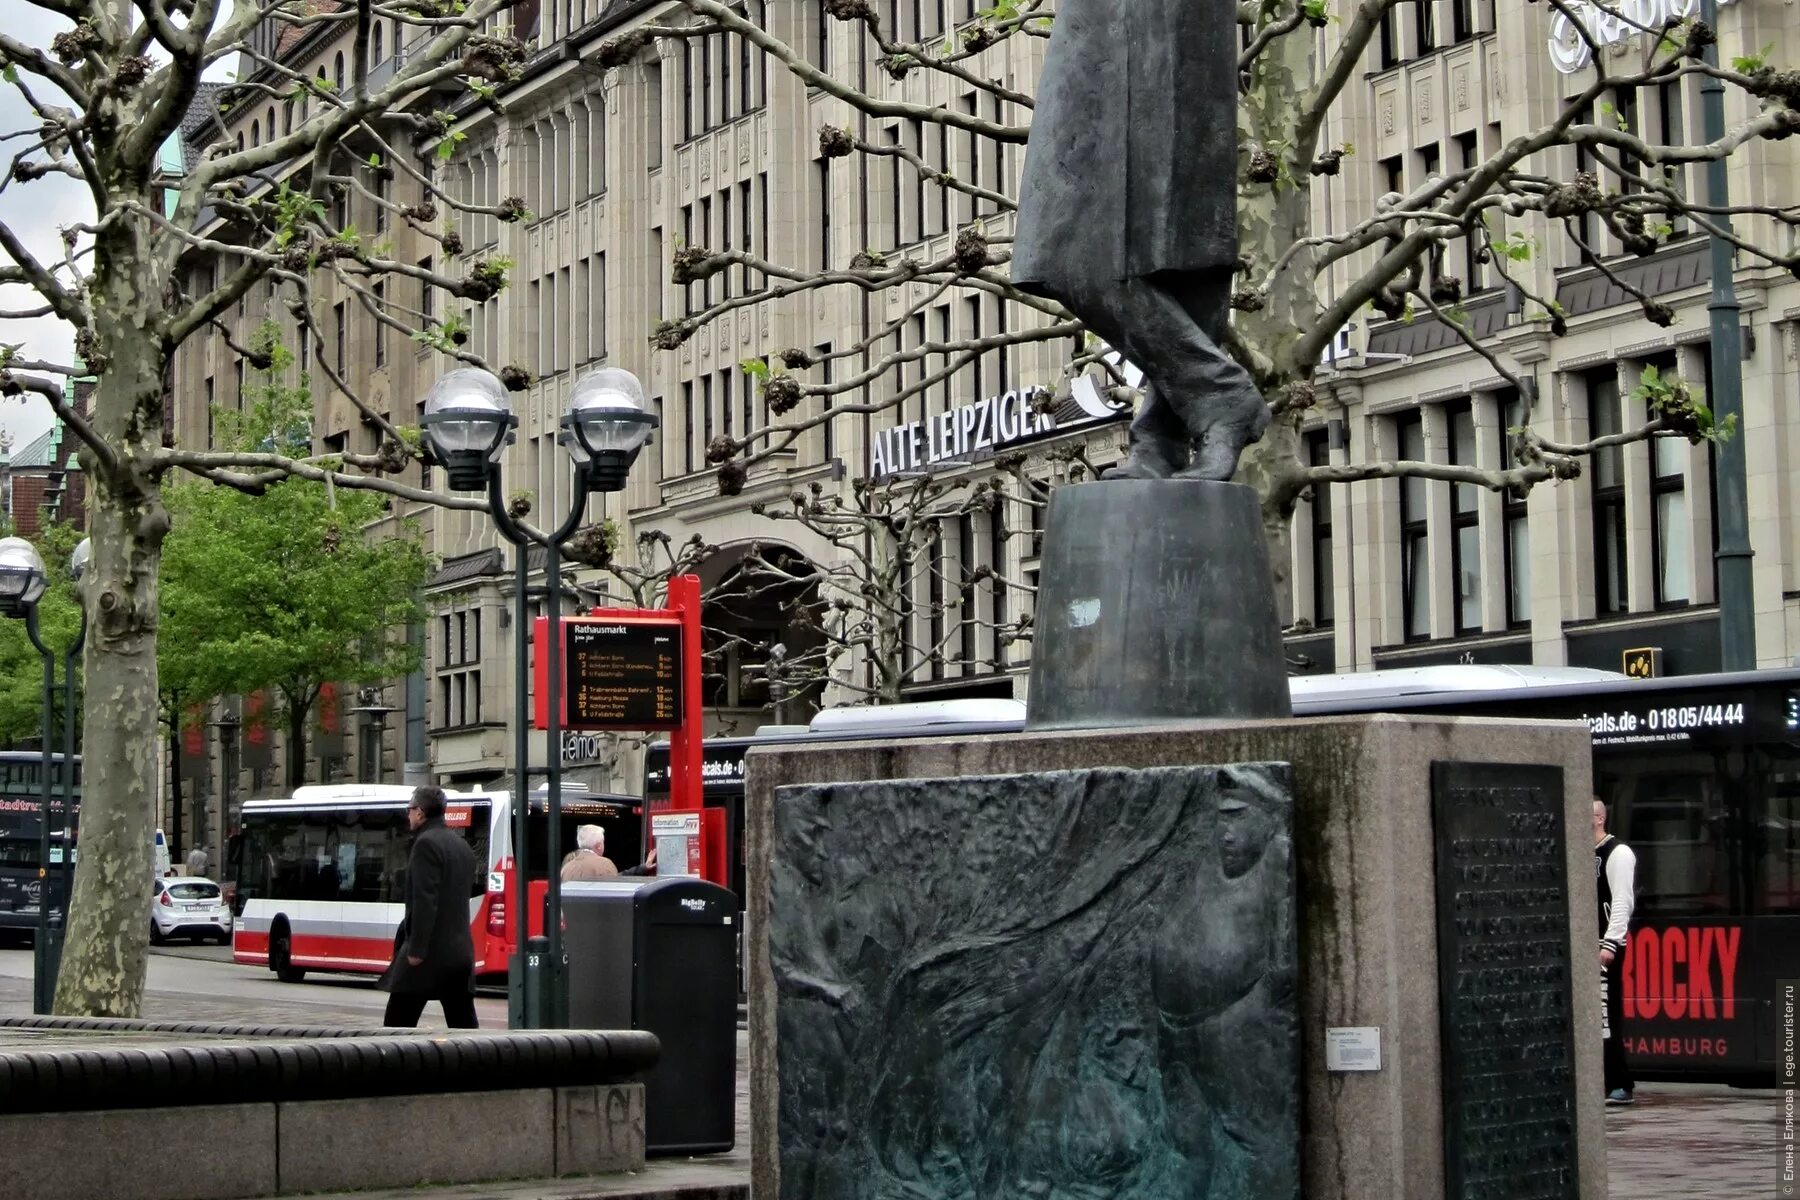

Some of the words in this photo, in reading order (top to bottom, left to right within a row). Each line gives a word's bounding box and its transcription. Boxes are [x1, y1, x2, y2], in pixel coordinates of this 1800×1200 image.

[871, 420, 921, 476] ALTE
[927, 384, 1053, 461] LEIPZIGER
[574, 624, 627, 634] Rathausmarkt
[528, 955, 539, 967] 33
[1622, 1036, 1727, 1056] HAMBURG
